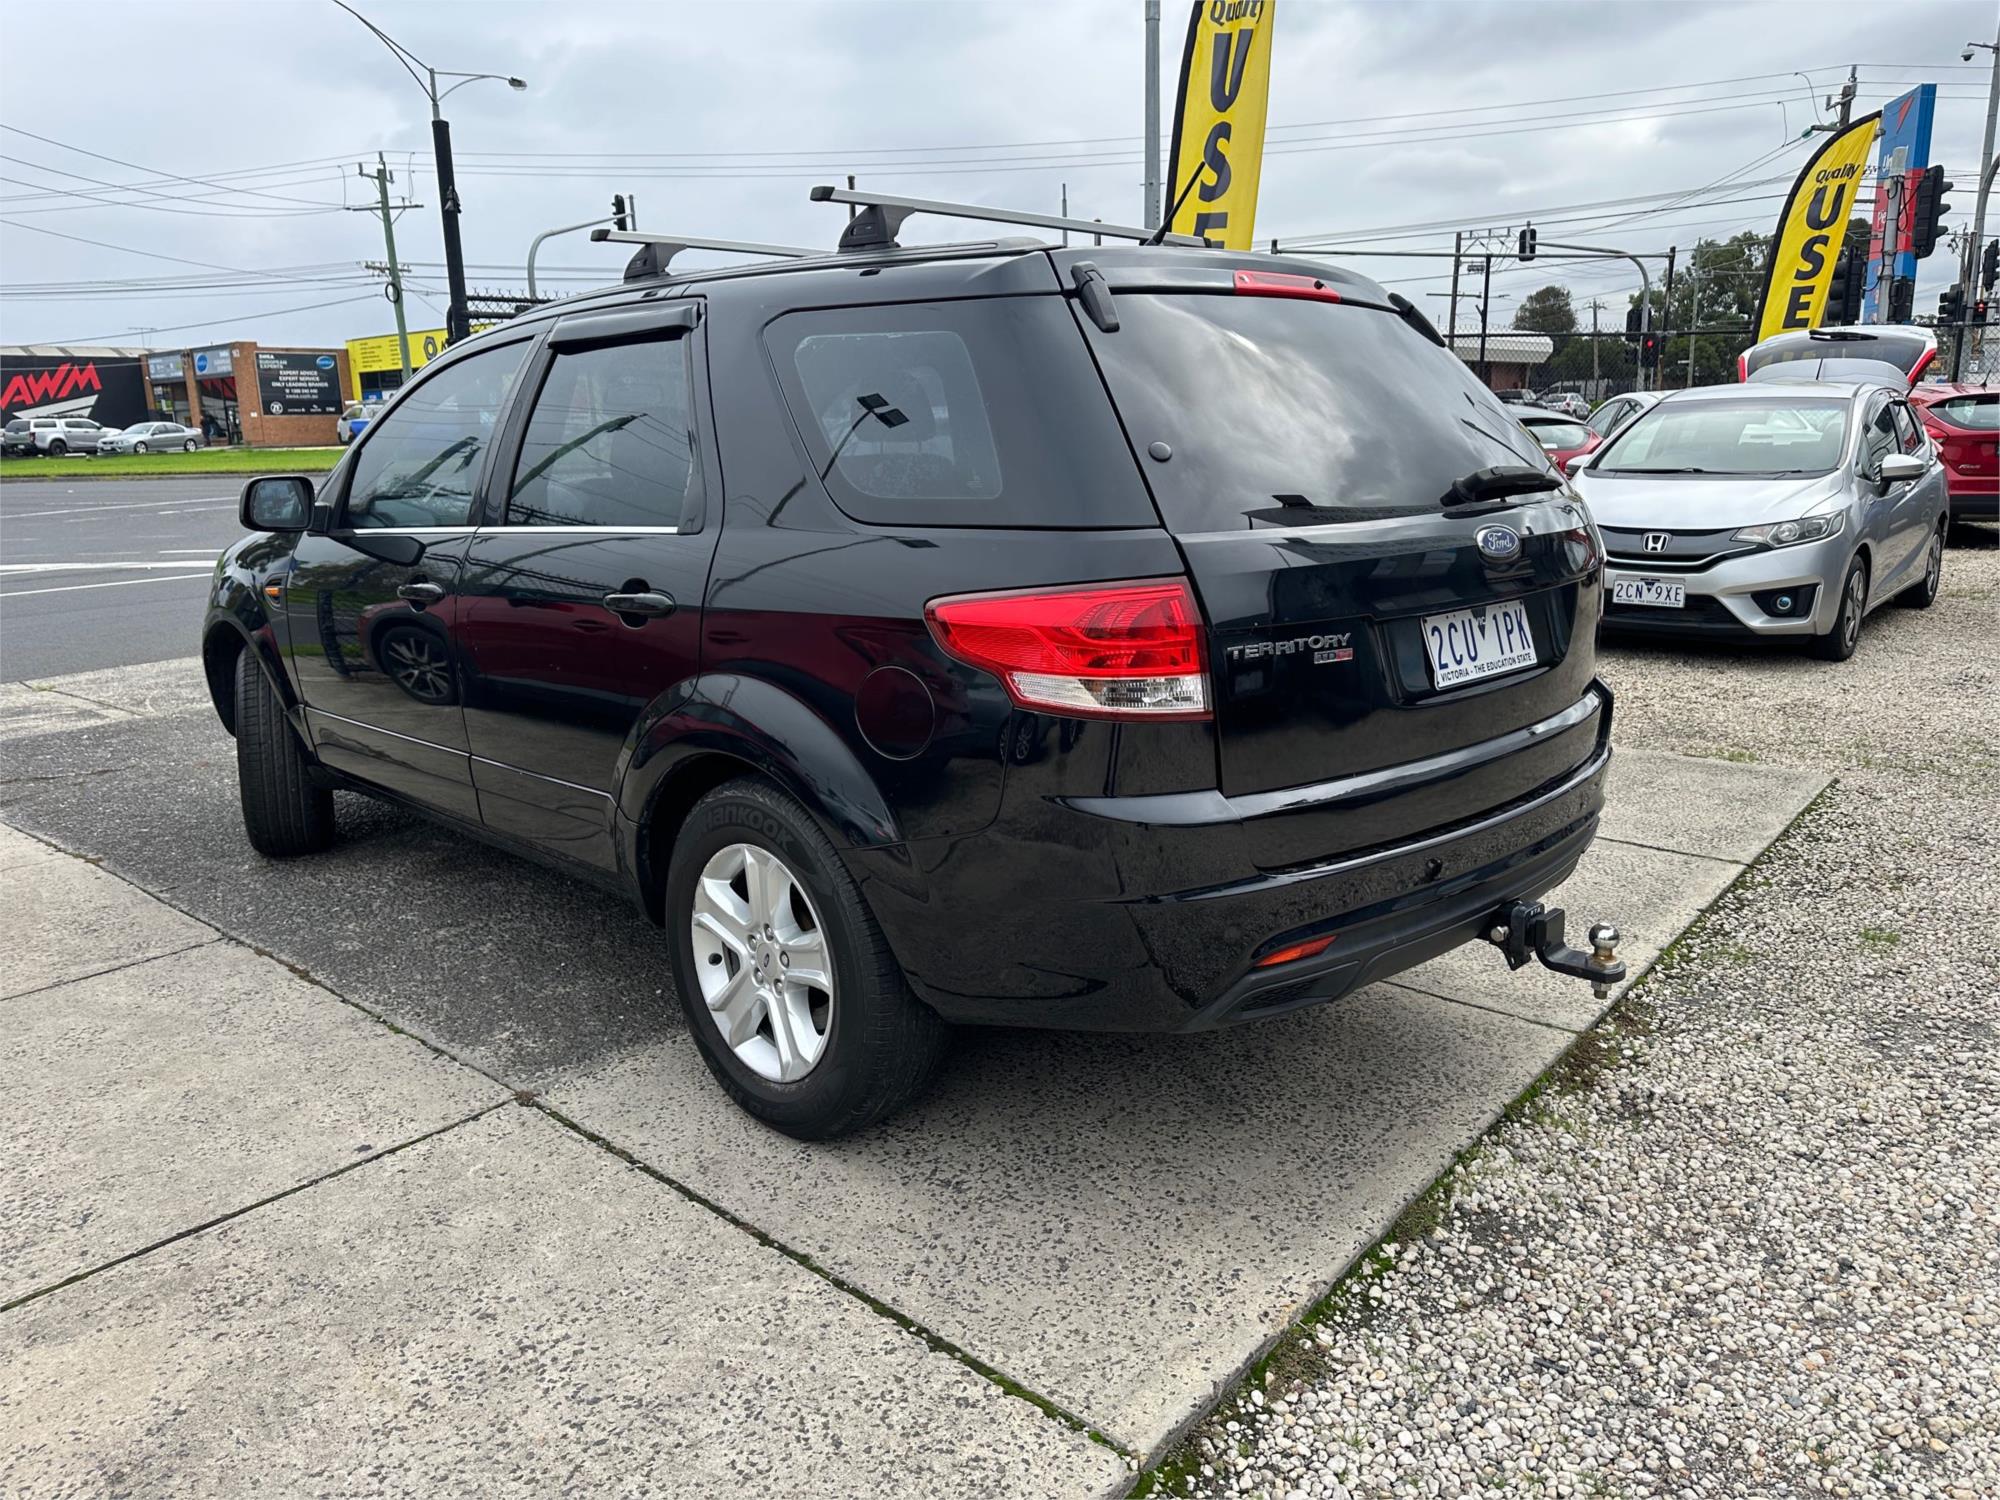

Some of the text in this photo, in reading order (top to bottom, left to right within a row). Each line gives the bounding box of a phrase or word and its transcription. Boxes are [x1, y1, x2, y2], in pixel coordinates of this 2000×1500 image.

[1815, 163, 1861, 184] Quality
[0, 361, 102, 411] AWM
[1487, 532, 1513, 550] Ford
[1616, 583, 1643, 599] 2CN
[1655, 585, 1682, 602] 9XE
[1227, 632, 1351, 660] TERRITORY
[1431, 608, 1531, 670] 2CU 1PK
[1440, 666, 1470, 682] VICTORIA
[1474, 663, 1486, 674] THE
[1486, 655, 1517, 670] EDUCATION
[1516, 651, 1532, 664] STATE
